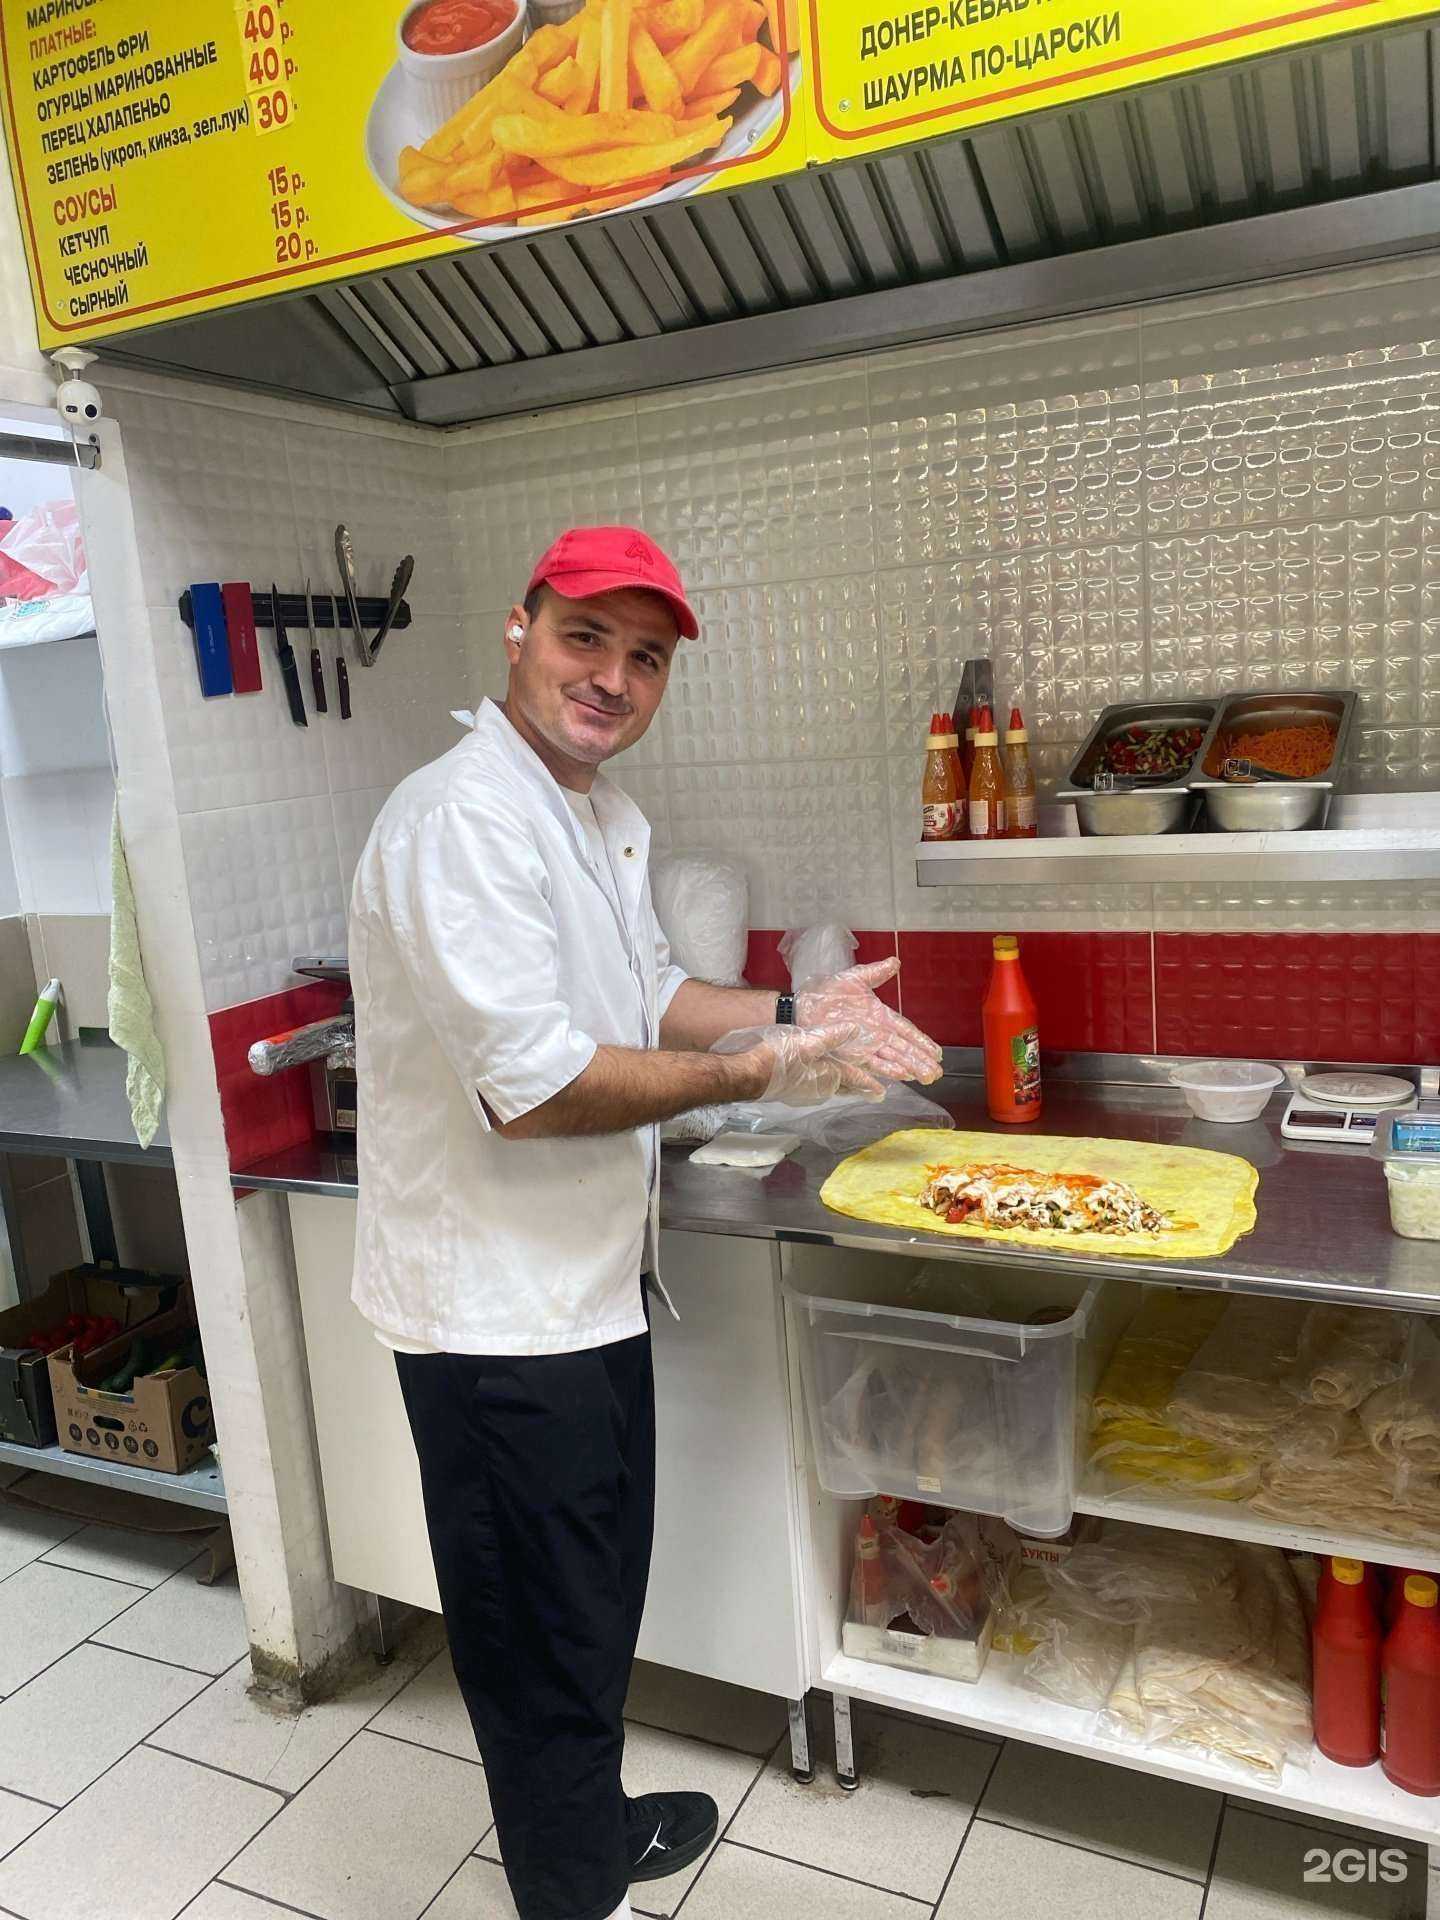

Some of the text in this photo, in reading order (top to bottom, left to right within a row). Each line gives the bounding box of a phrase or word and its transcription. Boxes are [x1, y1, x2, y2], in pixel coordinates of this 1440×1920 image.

[29, 18, 97, 61] ПЛАТНЫЕ:
[245, 5, 294, 44] 40 р.
[33, 30, 149, 91] КАРТОФЕЛЬ ФРИ
[250, 47, 298, 84] 40 р.
[863, 11, 1121, 110] ШАУРМА ПО-ЦАРСКИ
[37, 41, 217, 122] ОГУРЦЫ МАРИНОВАННЫЕ
[41, 92, 171, 153] ПЕРЕЦ ХАЛАПЕНЬО
[257, 90, 288, 129] 30
[47, 100, 250, 185] ЗЕЛЕНЬ (укроп, кинза, зел.лук)
[268, 166, 305, 197] 15 р.
[54, 184, 118, 226] СОУСЫ
[271, 200, 309, 230] 15 р.
[58, 225, 110, 257] КЕТЧУП
[275, 232, 319, 263] 20 р.
[64, 241, 149, 286] ЧЕСНОЧНЫЙ
[69, 279, 129, 317] СЫРНЫЙ
